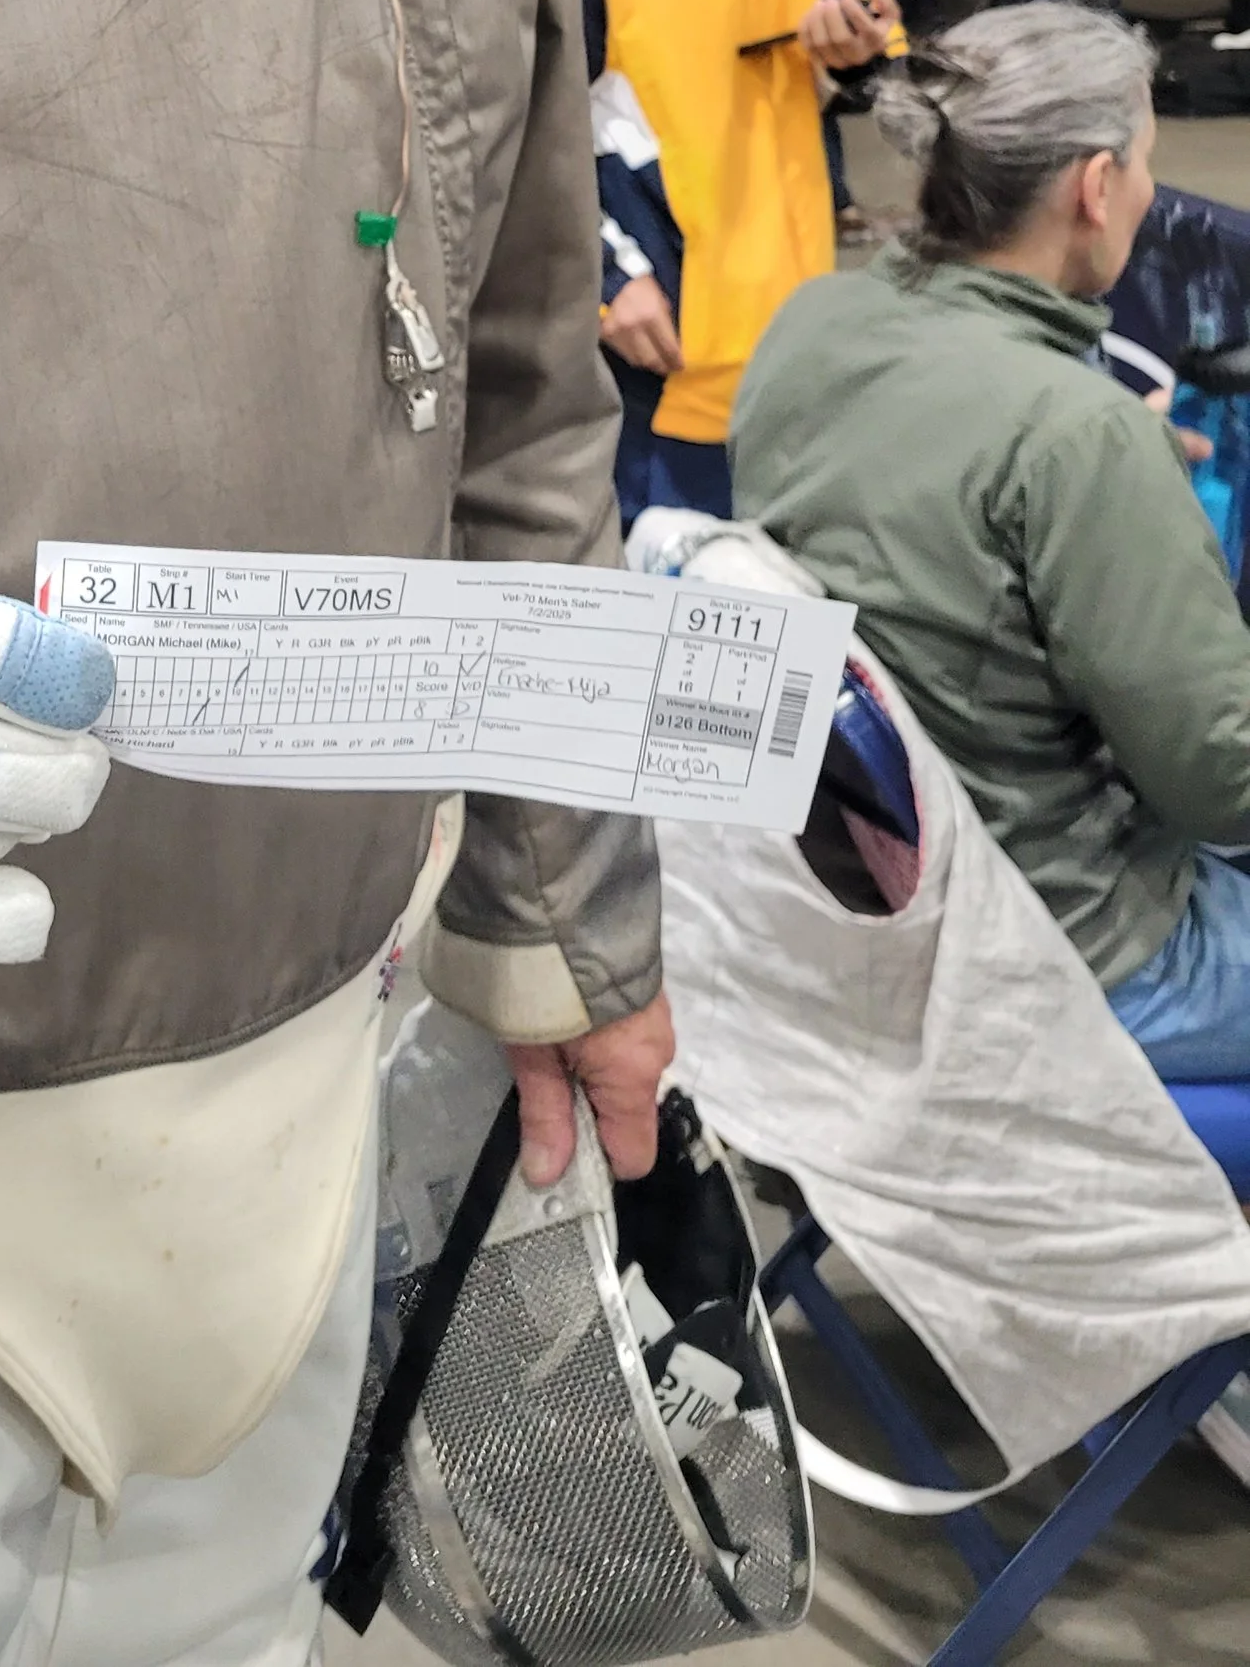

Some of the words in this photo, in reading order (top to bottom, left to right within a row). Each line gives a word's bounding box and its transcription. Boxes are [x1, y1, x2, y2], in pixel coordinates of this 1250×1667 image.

[88, 564, 112, 574] Table
[160, 568, 180, 578] Strip
[225, 572, 247, 581] Start
[250, 573, 270, 582] Time
[334, 575, 358, 584] Event
[80, 576, 116, 605] 32
[146, 581, 197, 610] M1
[294, 587, 392, 611] V70MS
[538, 595, 568, 608] Men's
[571, 598, 601, 610] Saber
[710, 600, 730, 611] Bout
[65, 614, 88, 624] Seed
[100, 617, 125, 627] Name
[154, 619, 173, 628] SMF
[237, 621, 257, 631] USA
[688, 608, 761, 641] 9111
[264, 623, 288, 631] Cards
[97, 633, 155, 647] MORGAN
[158, 634, 203, 648] Michael
[206, 635, 242, 650] (Mike)
[415, 681, 448, 692] Score
[655, 713, 693, 730] 9126
[698, 719, 752, 741] Bottom
[646, 751, 719, 784] Morgan
[654, 1373, 696, 1426] Pa
